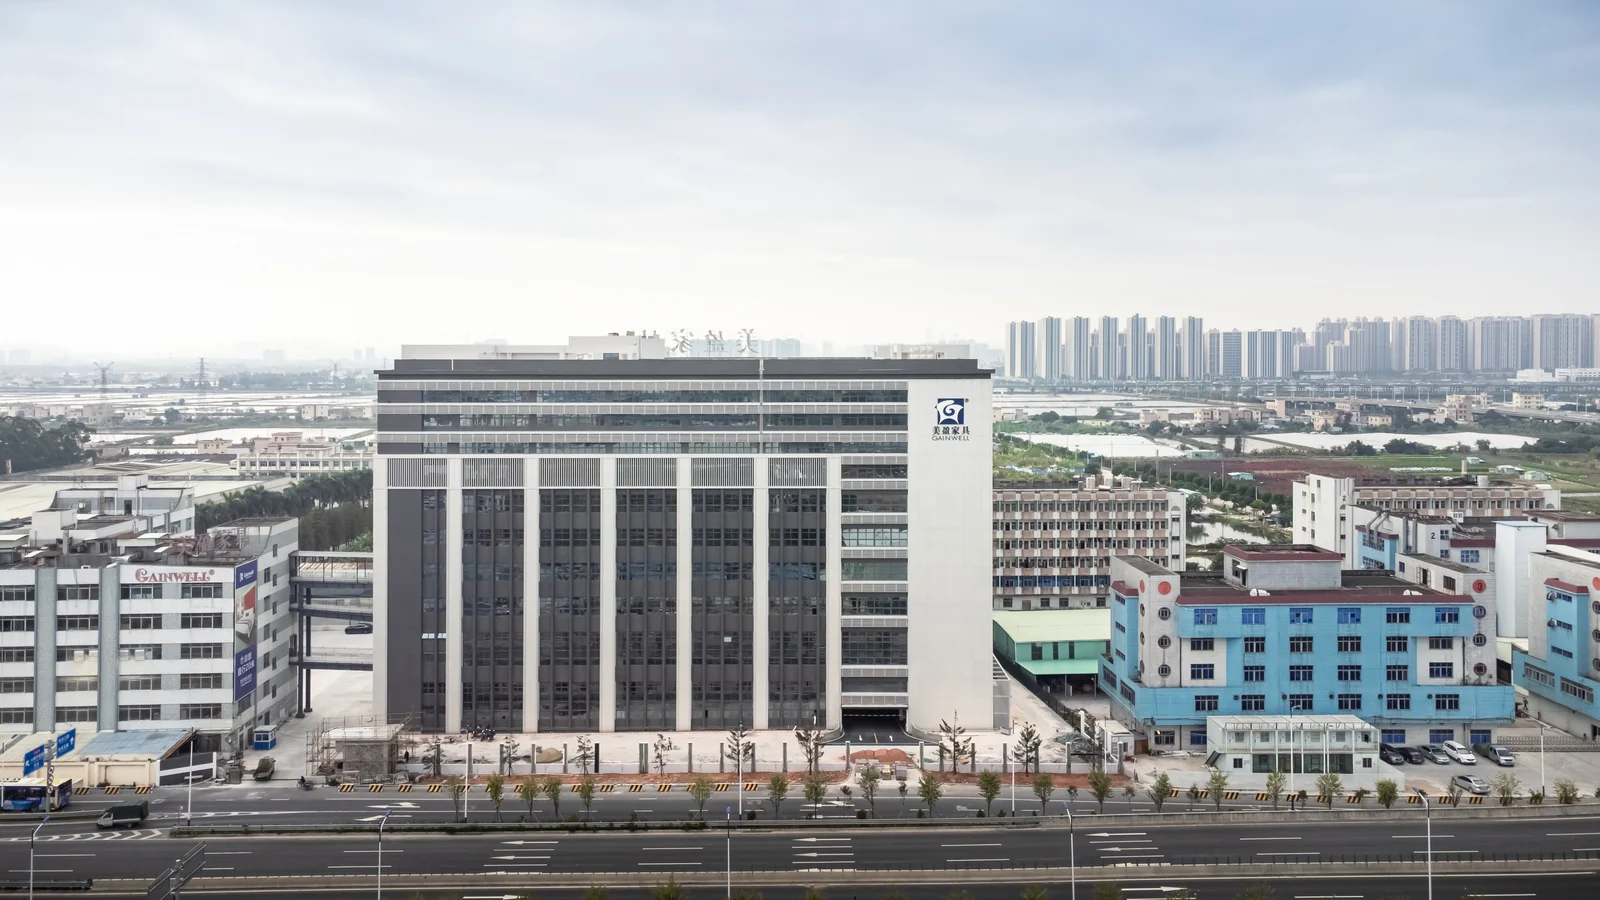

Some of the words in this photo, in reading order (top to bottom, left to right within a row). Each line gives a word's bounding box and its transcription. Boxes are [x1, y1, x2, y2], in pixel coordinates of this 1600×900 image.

[932, 426, 970, 435] 美盈家具
[1430, 532, 1436, 540] 2
[1478, 582, 1483, 590] 3
